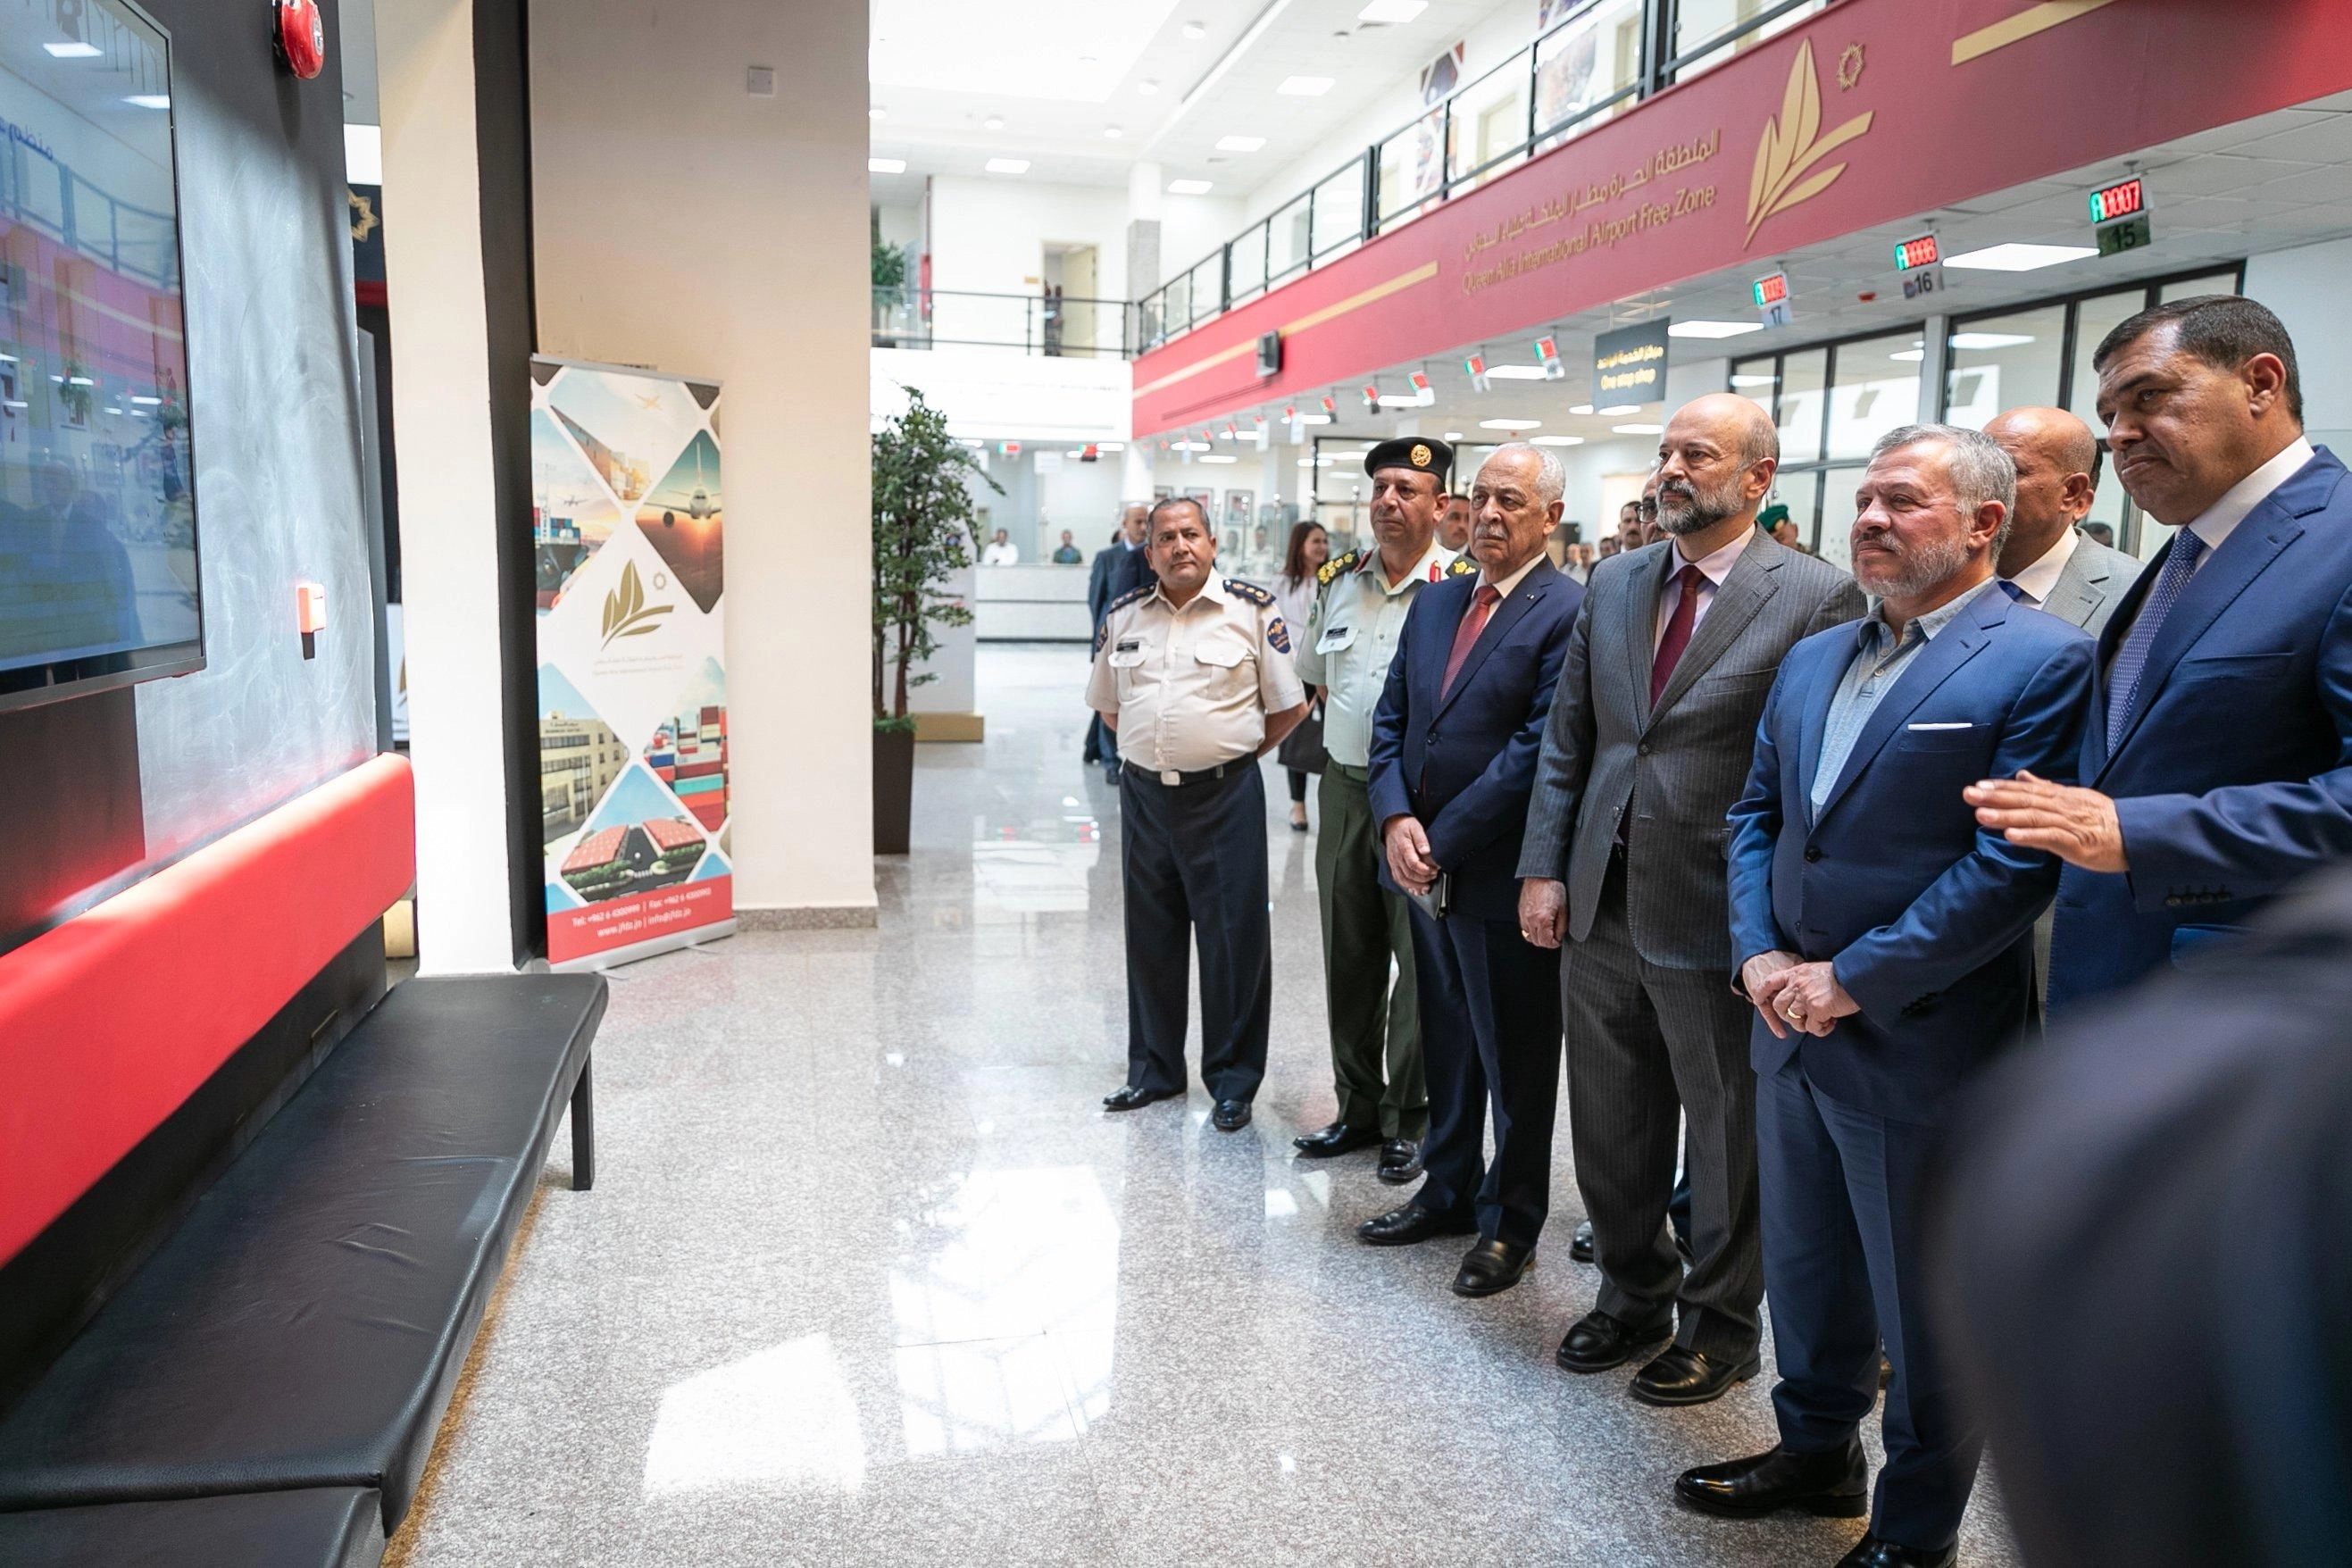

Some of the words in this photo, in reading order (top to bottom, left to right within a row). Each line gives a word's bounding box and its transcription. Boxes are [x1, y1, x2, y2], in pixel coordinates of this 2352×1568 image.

[1656, 128, 1720, 175] المنطقة
[1609, 156, 1655, 199] الحرة
[2089, 180, 2139, 223] A0007
[1463, 271, 1497, 296] Queen
[1518, 222, 1590, 273] International
[1592, 211, 1639, 250] Airport
[1640, 202, 1672, 230] Free
[1673, 184, 1717, 217] Zone
[2112, 222, 2136, 251] 15
[1914, 271, 1932, 294] 16
[1770, 304, 1782, 325] 17
